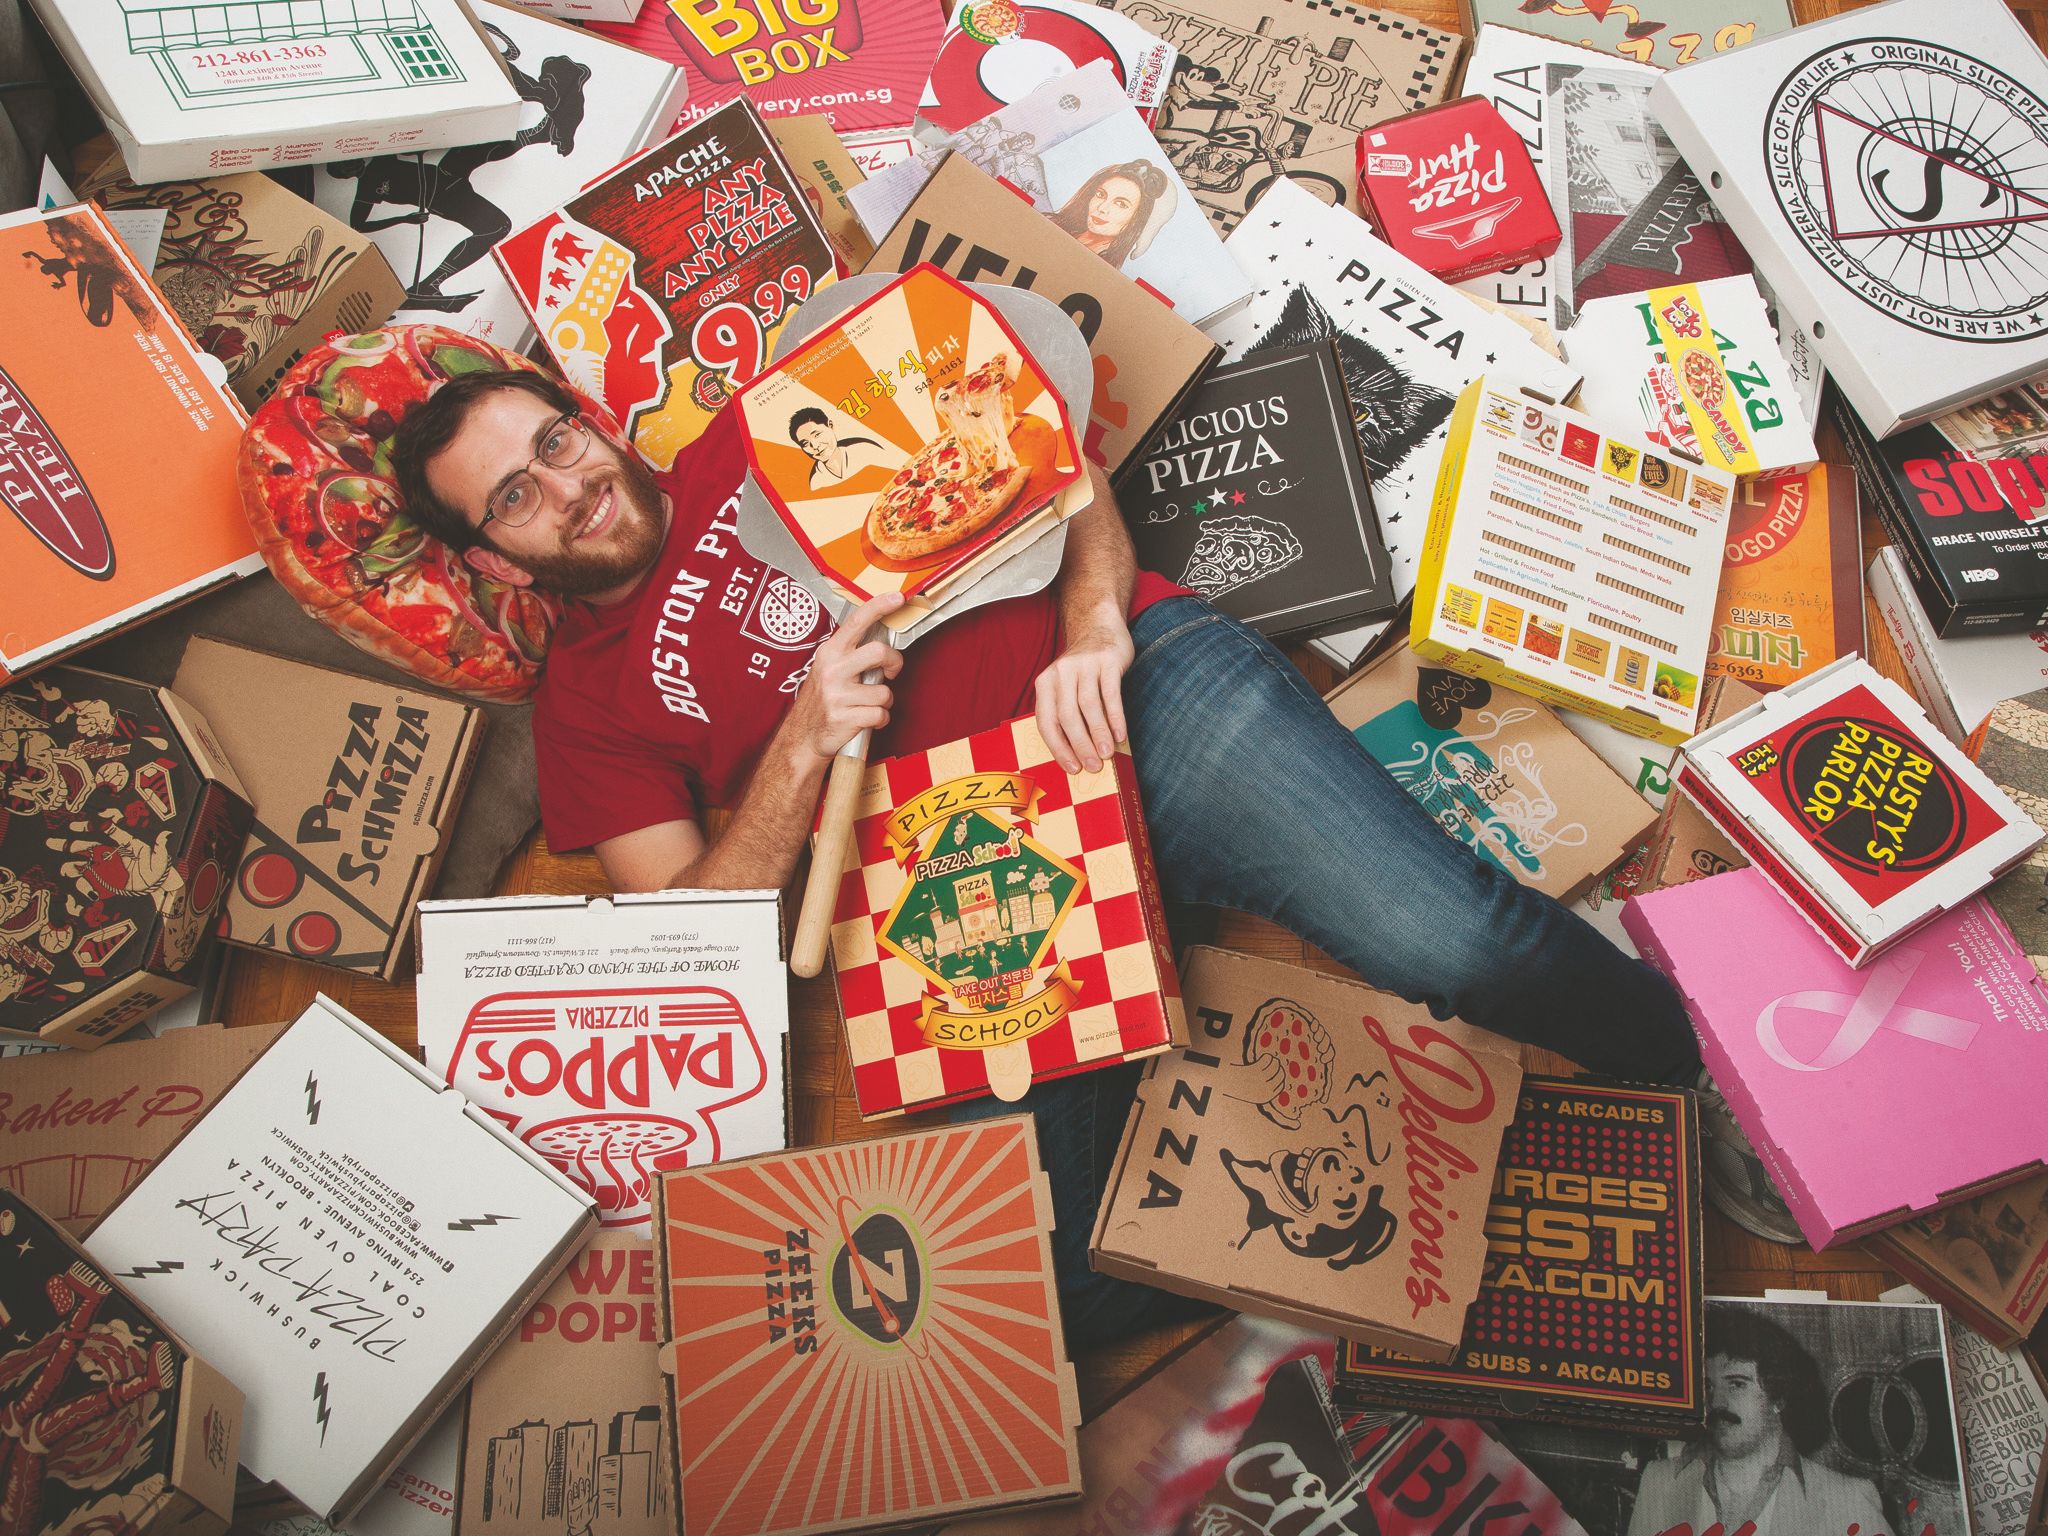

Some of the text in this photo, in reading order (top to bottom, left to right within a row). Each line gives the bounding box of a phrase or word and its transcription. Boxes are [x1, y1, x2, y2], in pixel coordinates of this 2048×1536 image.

[667, 0, 839, 57] BIG
[192, 44, 327, 68] 212-861-3363
[215, 62, 322, 78] 1248 Lexington Avenue
[731, 28, 851, 86] BOX
[1870, 44, 2020, 101] ORIGINAL SLICE
[1290, 56, 1383, 134] PIE
[635, 136, 726, 201] APACHE
[685, 156, 731, 187] PIZZA
[705, 158, 768, 216] ANY
[1409, 132, 1507, 213] Pizza Hut
[688, 180, 787, 254] PIZZA
[1772, 56, 2026, 336] WE ARE NOT JUST A PIZZERIA. SLICE OF YOUR LIFE
[664, 198, 798, 299] ANY SIZE
[696, 273, 744, 308] ONLY
[1336, 259, 1464, 360] PIZZA
[1397, 278, 1436, 305] GLUTEN FREE
[147, 351, 168, 373] ISN'T
[148, 331, 168, 355] MINE
[926, 335, 959, 365] 피자
[163, 371, 193, 411] WINGNUT
[170, 361, 191, 388] SLICE
[185, 385, 204, 407] LAST
[909, 357, 969, 397] 543-4161
[189, 407, 211, 435] SINCE
[200, 404, 215, 423] THE
[1702, 397, 1748, 456] CANDY
[1144, 433, 1285, 497] PIZZA
[1940, 449, 1979, 462] THE
[1521, 474, 1547, 487] deliveries
[1770, 481, 1805, 542] PIZZA
[1932, 526, 2041, 549] BRACE YOURSELF
[1992, 541, 2031, 555] To Order
[719, 565, 759, 617] EST.
[1961, 567, 2000, 584] HBO
[1730, 606, 1794, 631] 임실치즈
[651, 569, 711, 724] BOSTON
[747, 652, 772, 680] 19
[1427, 666, 1461, 703] VIVI
[1432, 671, 1475, 715] DOVE
[1739, 745, 1771, 768] HOT
[1804, 721, 1870, 821] PARLOR
[1848, 737, 1901, 810] PIZZA
[412, 774, 436, 827] schmizza.com
[897, 780, 1020, 833] PIZZA
[1867, 752, 1938, 864] RUSTY'S
[915, 853, 974, 883] PIZZA
[958, 877, 990, 895] PIZZA
[1732, 826, 1752, 847] Last
[1765, 863, 1786, 880] You
[1803, 902, 1830, 927] Great
[465, 958, 740, 978] HOME OF THE HAND CRAFTED PIZZA
[1963, 930, 1988, 965] DONATE
[952, 978, 1000, 998] TAKE OUT
[1949, 943, 2008, 1021] Thank You!
[1962, 916, 2043, 1031] PORTION OF YOUR PURCHASE
[1986, 965, 1999, 984] WILL
[1986, 938, 2041, 1019] AMERICAN CANCER
[1998, 986, 2015, 1006] GUYS
[566, 1006, 650, 1031] PIZZERIA
[934, 1001, 1064, 1042] SCHOOL
[2015, 1009, 2031, 1030] PIZZA
[1137, 1007, 1234, 1210] PIZZA
[1557, 1100, 1665, 1124] ARCADES
[320, 1151, 411, 1225] @pizzapartybushwick
[342, 1154, 405, 1205] @pizzapartybk
[1363, 1015, 1497, 1320] Delicious
[1494, 1167, 1668, 1212] RGES
[271, 1128, 443, 1264] WWW.FACEBOOK.COM/PIZZAPARTYBUSHWICK
[290, 1156, 418, 1259] WWW.BUSHWICKPIZZAPARTY.COM
[228, 1159, 424, 1318] COAL OVEN PIZZA
[261, 1156, 424, 1285] 254 IRVING AVENUE BROOKLYN
[175, 1191, 406, 1362] PIZZA PARTY
[763, 1248, 786, 1345] PIZZA
[785, 1228, 818, 1356] ZEEKS
[210, 1258, 320, 1349] BUSHWICK
[1466, 1351, 1672, 1390] SUBS ARCADES
